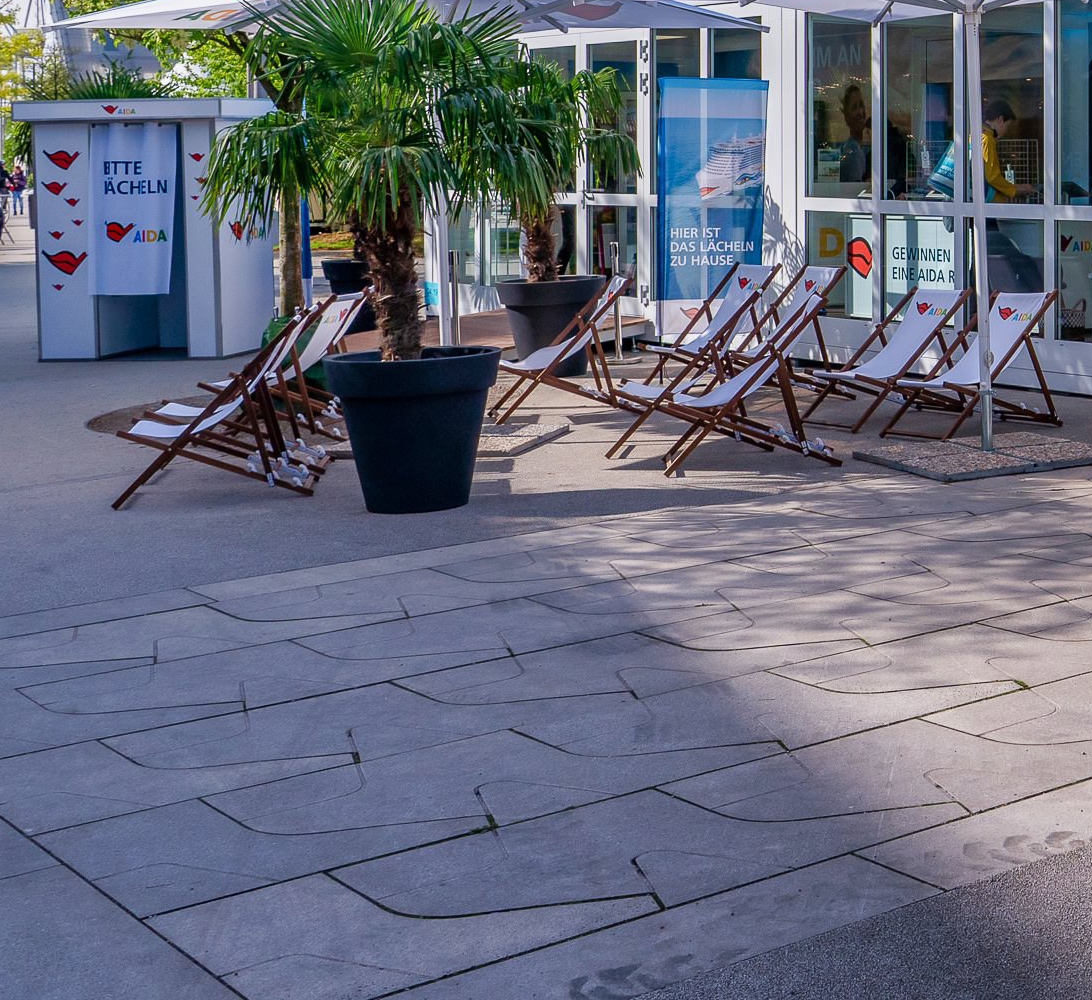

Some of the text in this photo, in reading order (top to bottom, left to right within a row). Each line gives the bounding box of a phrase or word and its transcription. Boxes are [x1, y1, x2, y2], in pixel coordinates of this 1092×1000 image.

[133, 229, 168, 243] AIDA
[670, 228, 721, 239] HIER IST
[670, 239, 754, 252] DAS LÄCHELN
[892, 246, 950, 262] GEWINNEN
[670, 255, 734, 267] ZU HAUSE
[892, 267, 915, 281] EINE
[918, 268, 945, 282] AIDA
